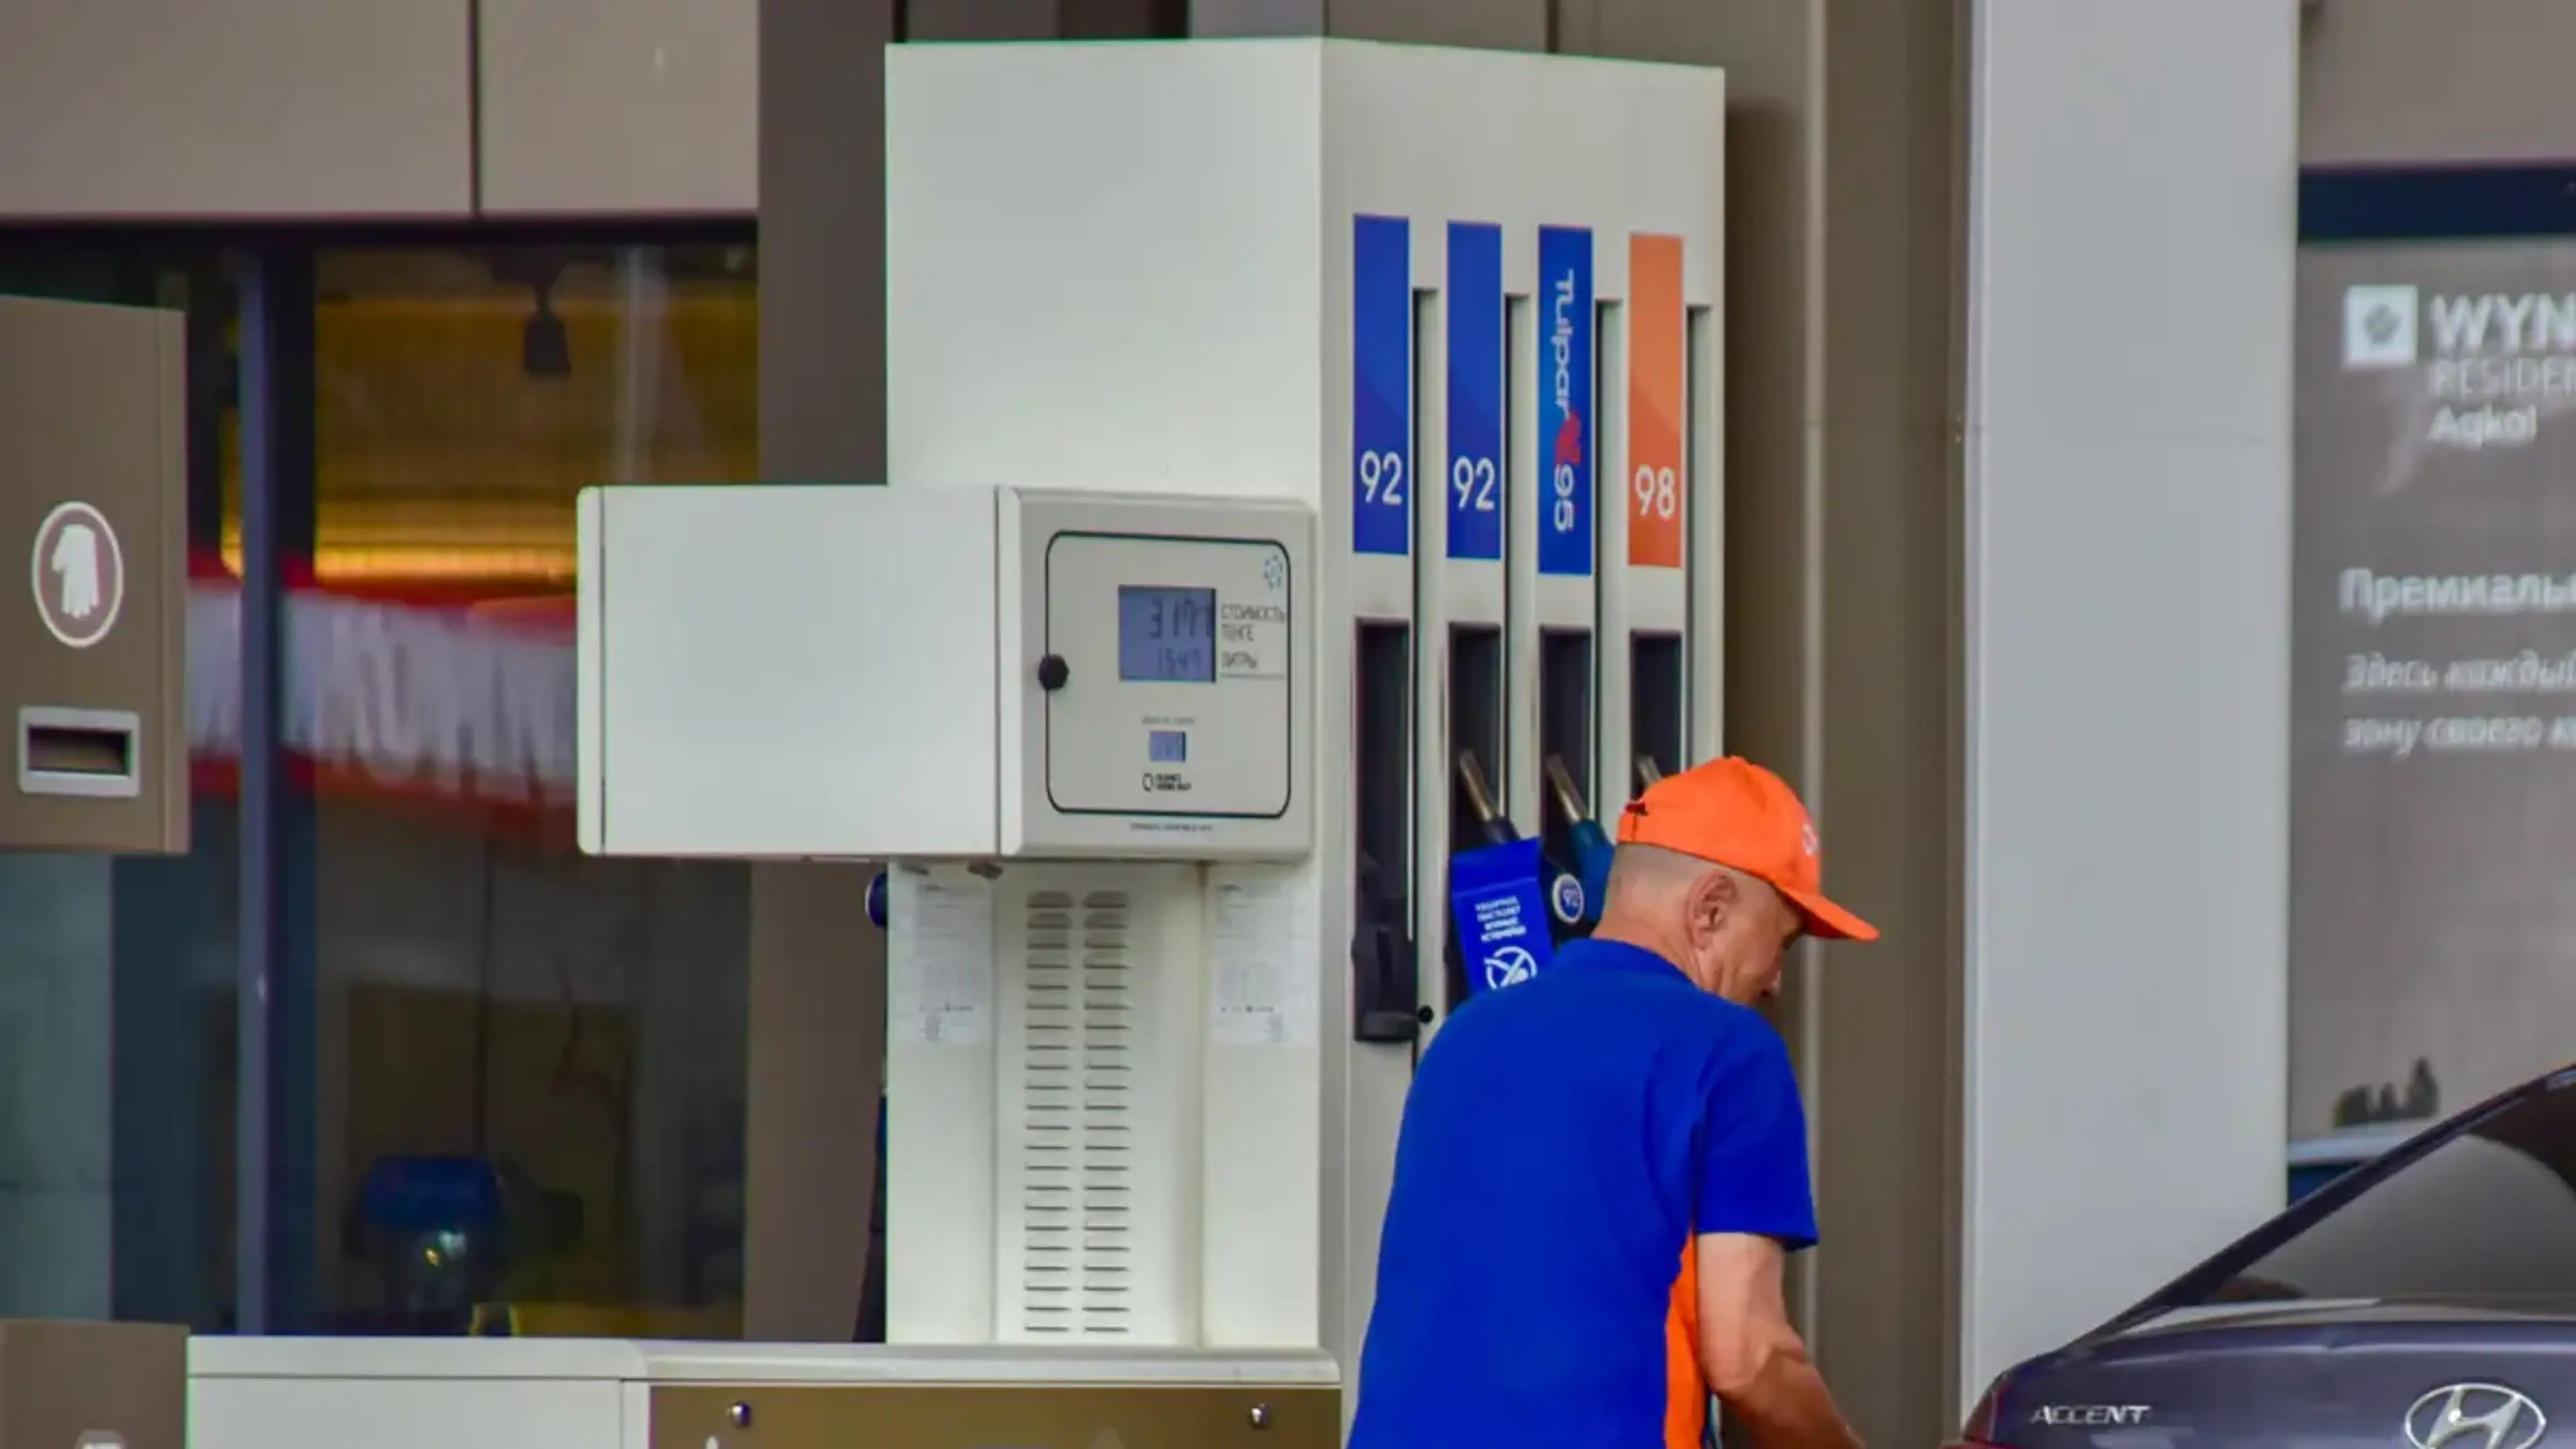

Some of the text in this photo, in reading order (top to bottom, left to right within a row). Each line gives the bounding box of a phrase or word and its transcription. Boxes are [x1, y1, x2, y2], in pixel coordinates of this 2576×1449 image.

[1551, 268, 1574, 533] Tulpar 95
[1360, 449, 1403, 506] 92
[1452, 455, 1495, 512] 92
[1634, 465, 1677, 523] 98
[2027, 1405, 2152, 1425] ACCENT
